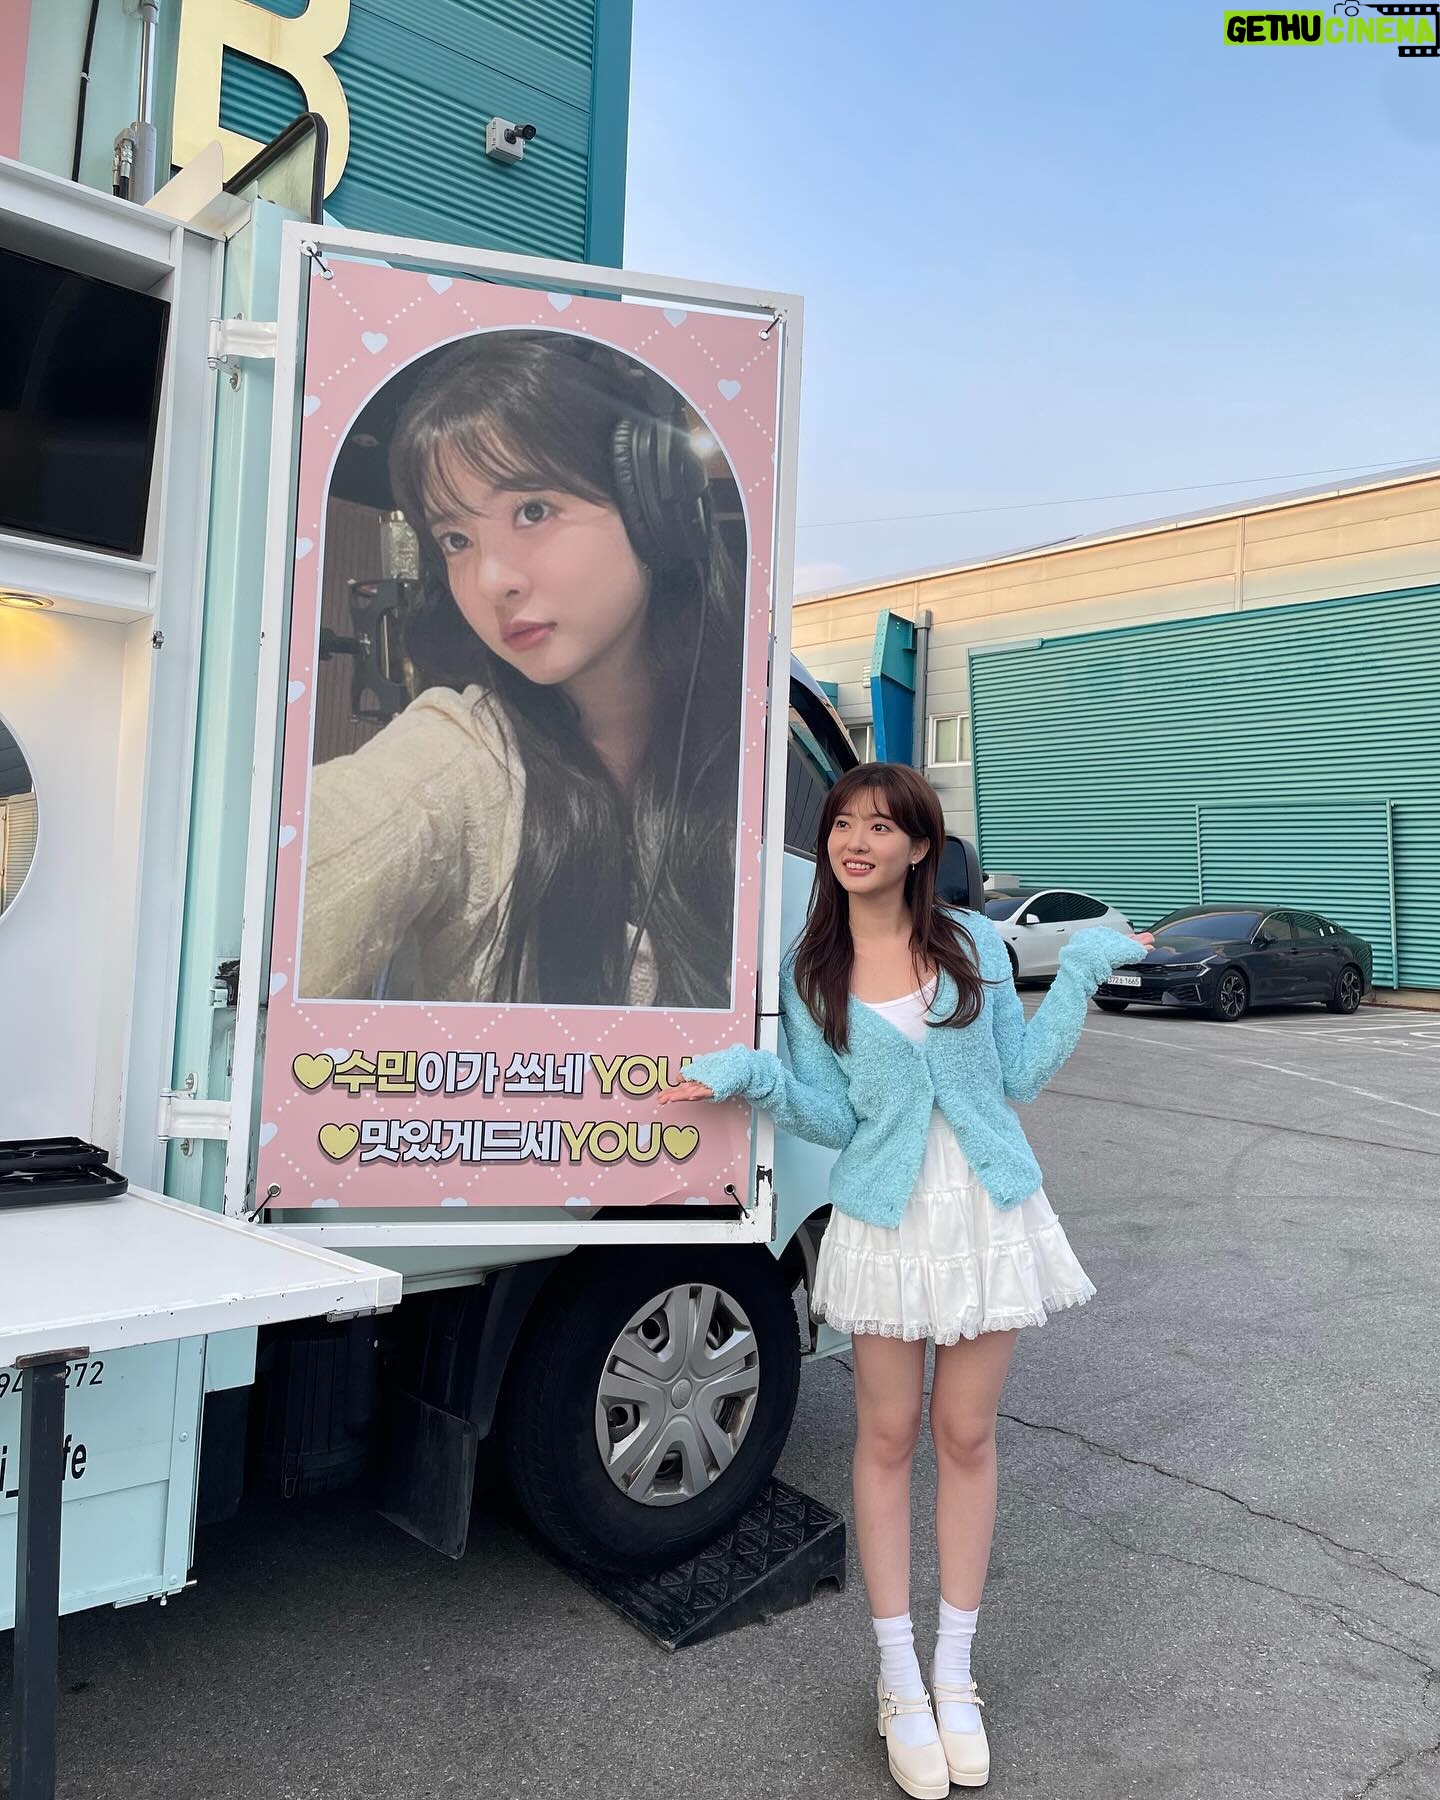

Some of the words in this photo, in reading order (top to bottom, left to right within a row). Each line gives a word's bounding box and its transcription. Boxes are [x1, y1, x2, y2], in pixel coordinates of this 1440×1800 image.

[333, 1050, 500, 1093] 수민이가
[503, 1052, 585, 1094] 쏘네
[590, 1055, 692, 1095] YOU
